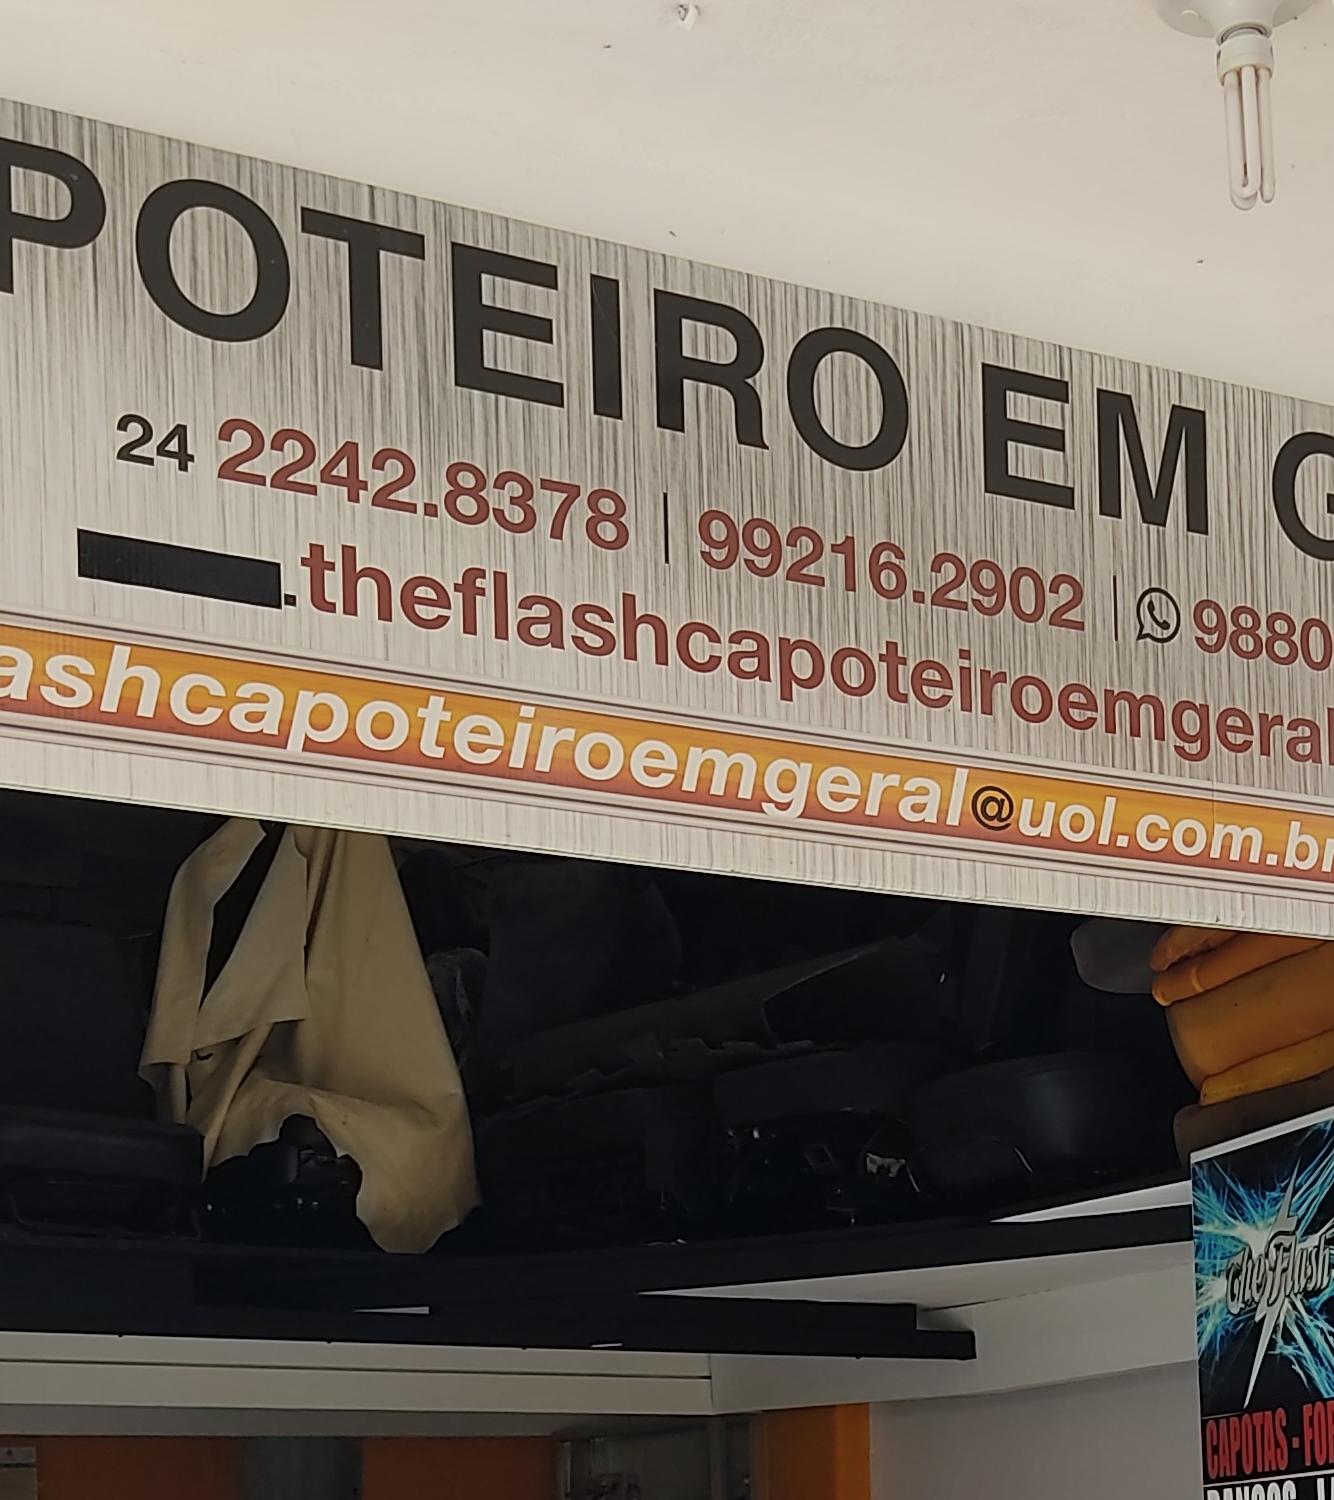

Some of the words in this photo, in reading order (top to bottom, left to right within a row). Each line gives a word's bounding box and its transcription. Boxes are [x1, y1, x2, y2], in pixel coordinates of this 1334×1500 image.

[116, 414, 195, 472] 24
[217, 418, 629, 550] 2242.8378
[699, 509, 1086, 632] 99216.2902
[978, 361, 1210, 537] EM
[1206, 1407, 1287, 1480] CAPOTAS
